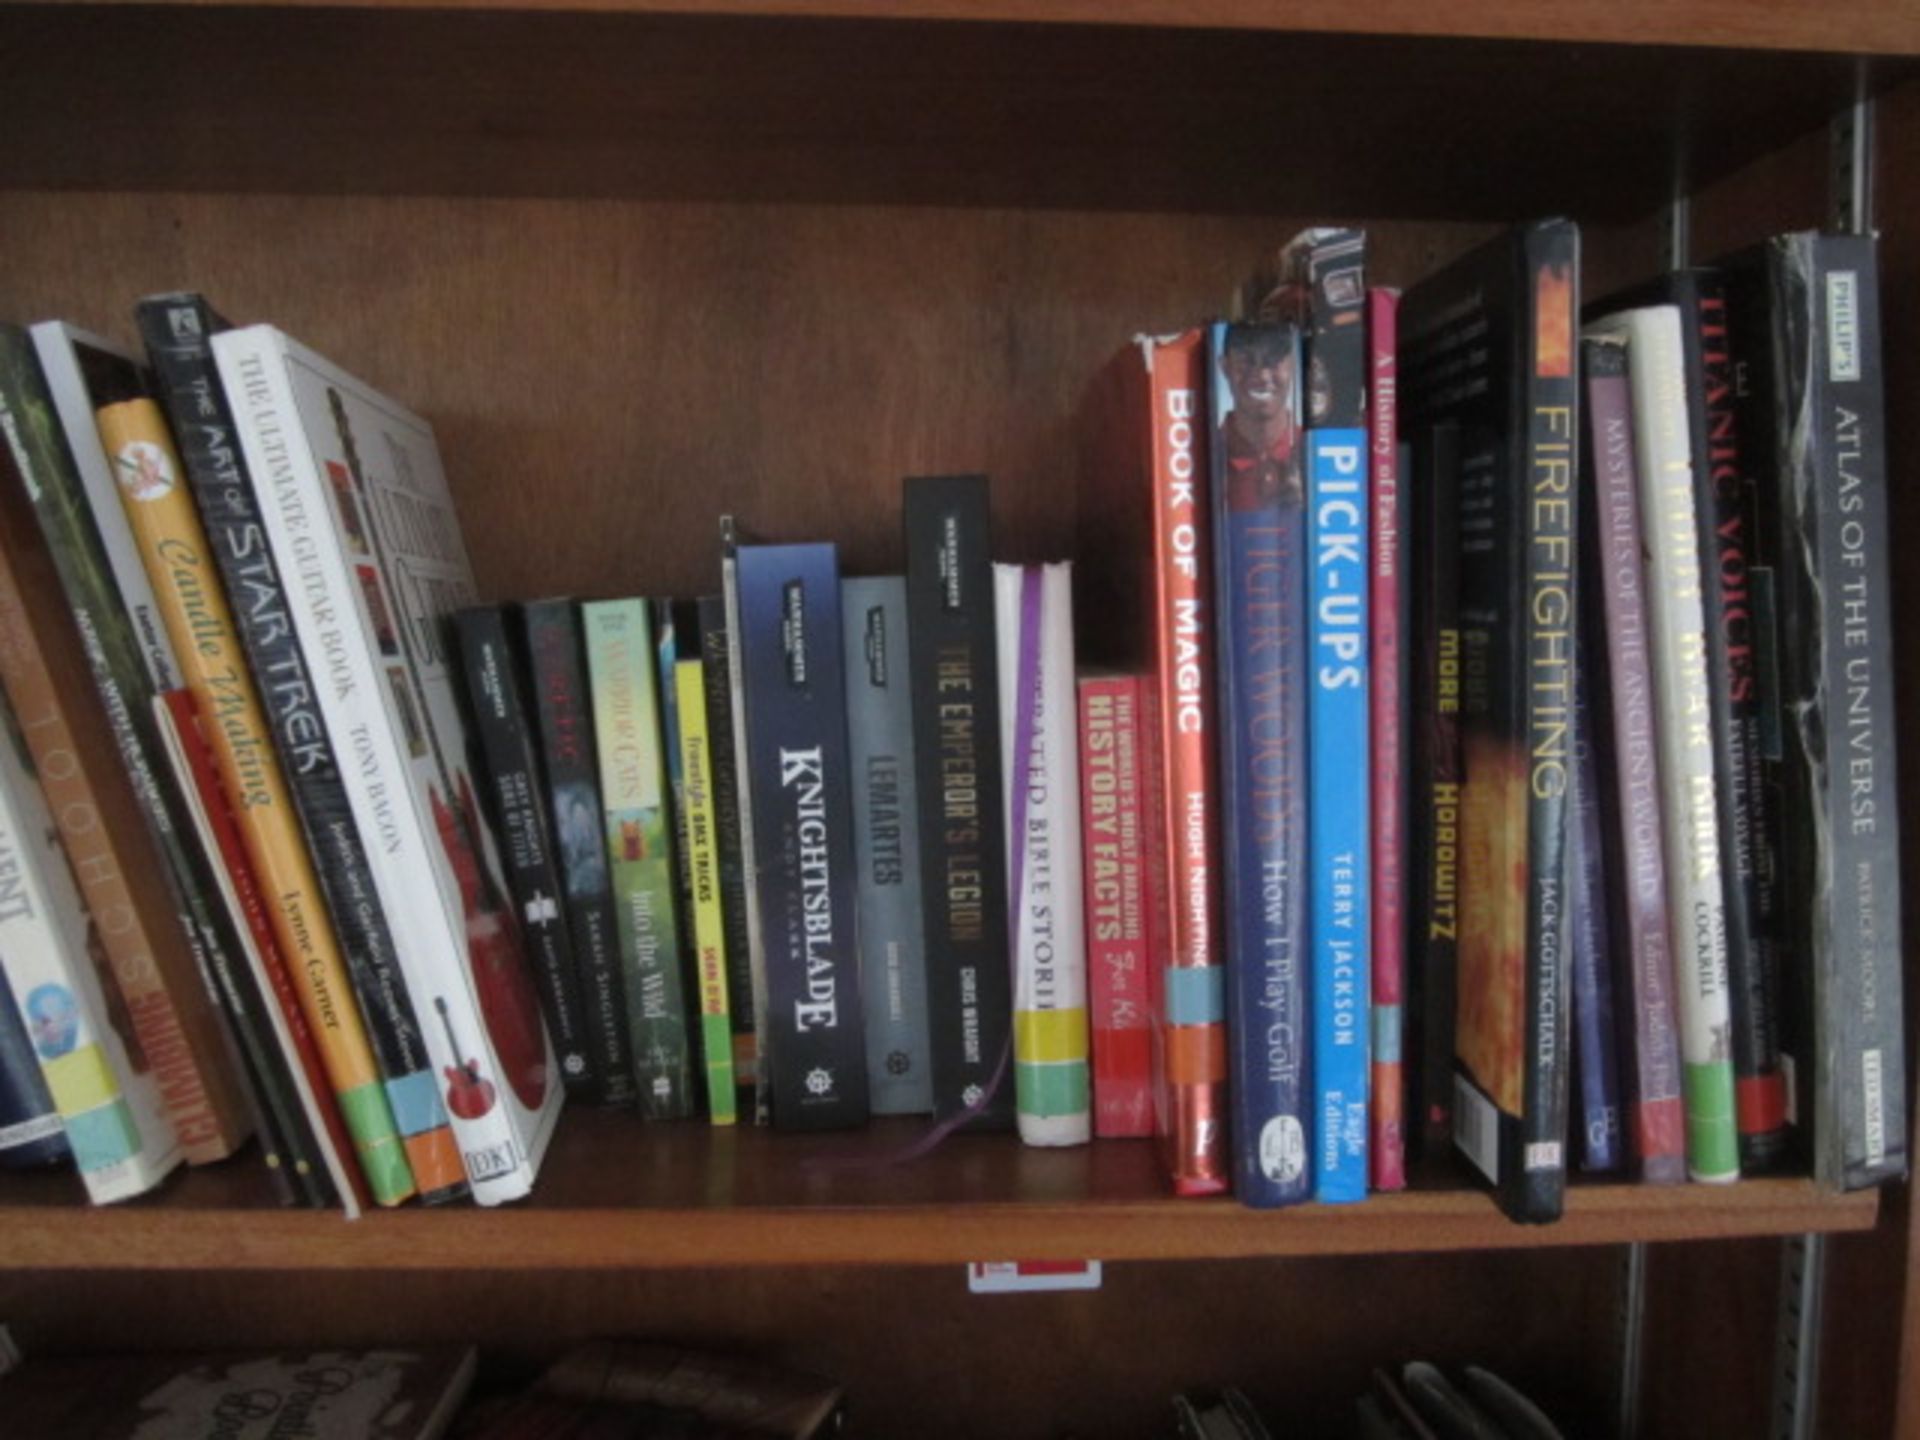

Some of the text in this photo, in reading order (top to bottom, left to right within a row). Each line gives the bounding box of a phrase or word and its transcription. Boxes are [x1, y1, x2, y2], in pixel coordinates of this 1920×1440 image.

[188, 375, 217, 417] THE
[1833, 280, 1854, 370] PHILIP'S
[200, 420, 240, 487] ART
[1373, 352, 1397, 576] A History of Fashion
[1699, 295, 1753, 702] TITANIC VOICES
[223, 517, 293, 646] STAR
[235, 350, 404, 855] THE ULTIMATE GUITAR BOOK TONY BACON
[788, 586, 805, 682] WARHAMMER
[942, 517, 961, 607] WARHAMMER
[1166, 388, 1202, 733] BOOK OF MAGIC
[1318, 445, 1359, 690] PICK-UPS
[1530, 406, 1572, 799] FIREFIGHTING
[1834, 404, 1876, 834] ATLAS OF THE UNIVERSE
[101, 677, 134, 733] WITH
[155, 531, 222, 662] Candle
[201, 660, 275, 811] Making
[262, 645, 331, 774] TREK
[1244, 523, 1298, 842] TIGER WOODS
[1602, 417, 1660, 898] MYSTERIES OF THE ANCIENT WORLD
[26, 706, 152, 979] SCHOOL
[611, 742, 644, 799] CATS
[866, 754, 903, 887] LEMARTES
[935, 645, 985, 941] THE EMPEROR'S LEGION
[1081, 695, 1123, 941] HISTORY FACTS
[1115, 694, 1142, 940] THE WORLD'S MOST AMAZING
[630, 889, 657, 930] Into
[695, 851, 711, 902] TRICKS
[778, 745, 836, 1032] KNIGHTSBLADE
[1185, 791, 1209, 967] HUGH NIGHTING
[1428, 782, 1458, 940] HOROWITZ
[276, 890, 343, 1032] Lynne Garner
[635, 934, 659, 968] the
[638, 972, 667, 1019] Wild
[959, 966, 977, 1004] CHRIS
[1110, 995, 1137, 1029] Ki
[1256, 860, 1295, 1083] How I Play Golf
[1330, 853, 1353, 1044] TERRY JACKSON
[1537, 878, 1557, 1066] JACK GOTTSCHALK
[1691, 900, 1717, 999] COCKRILL
[1322, 1090, 1342, 1170] Editions
[1345, 1102, 1365, 1155] Eagle
